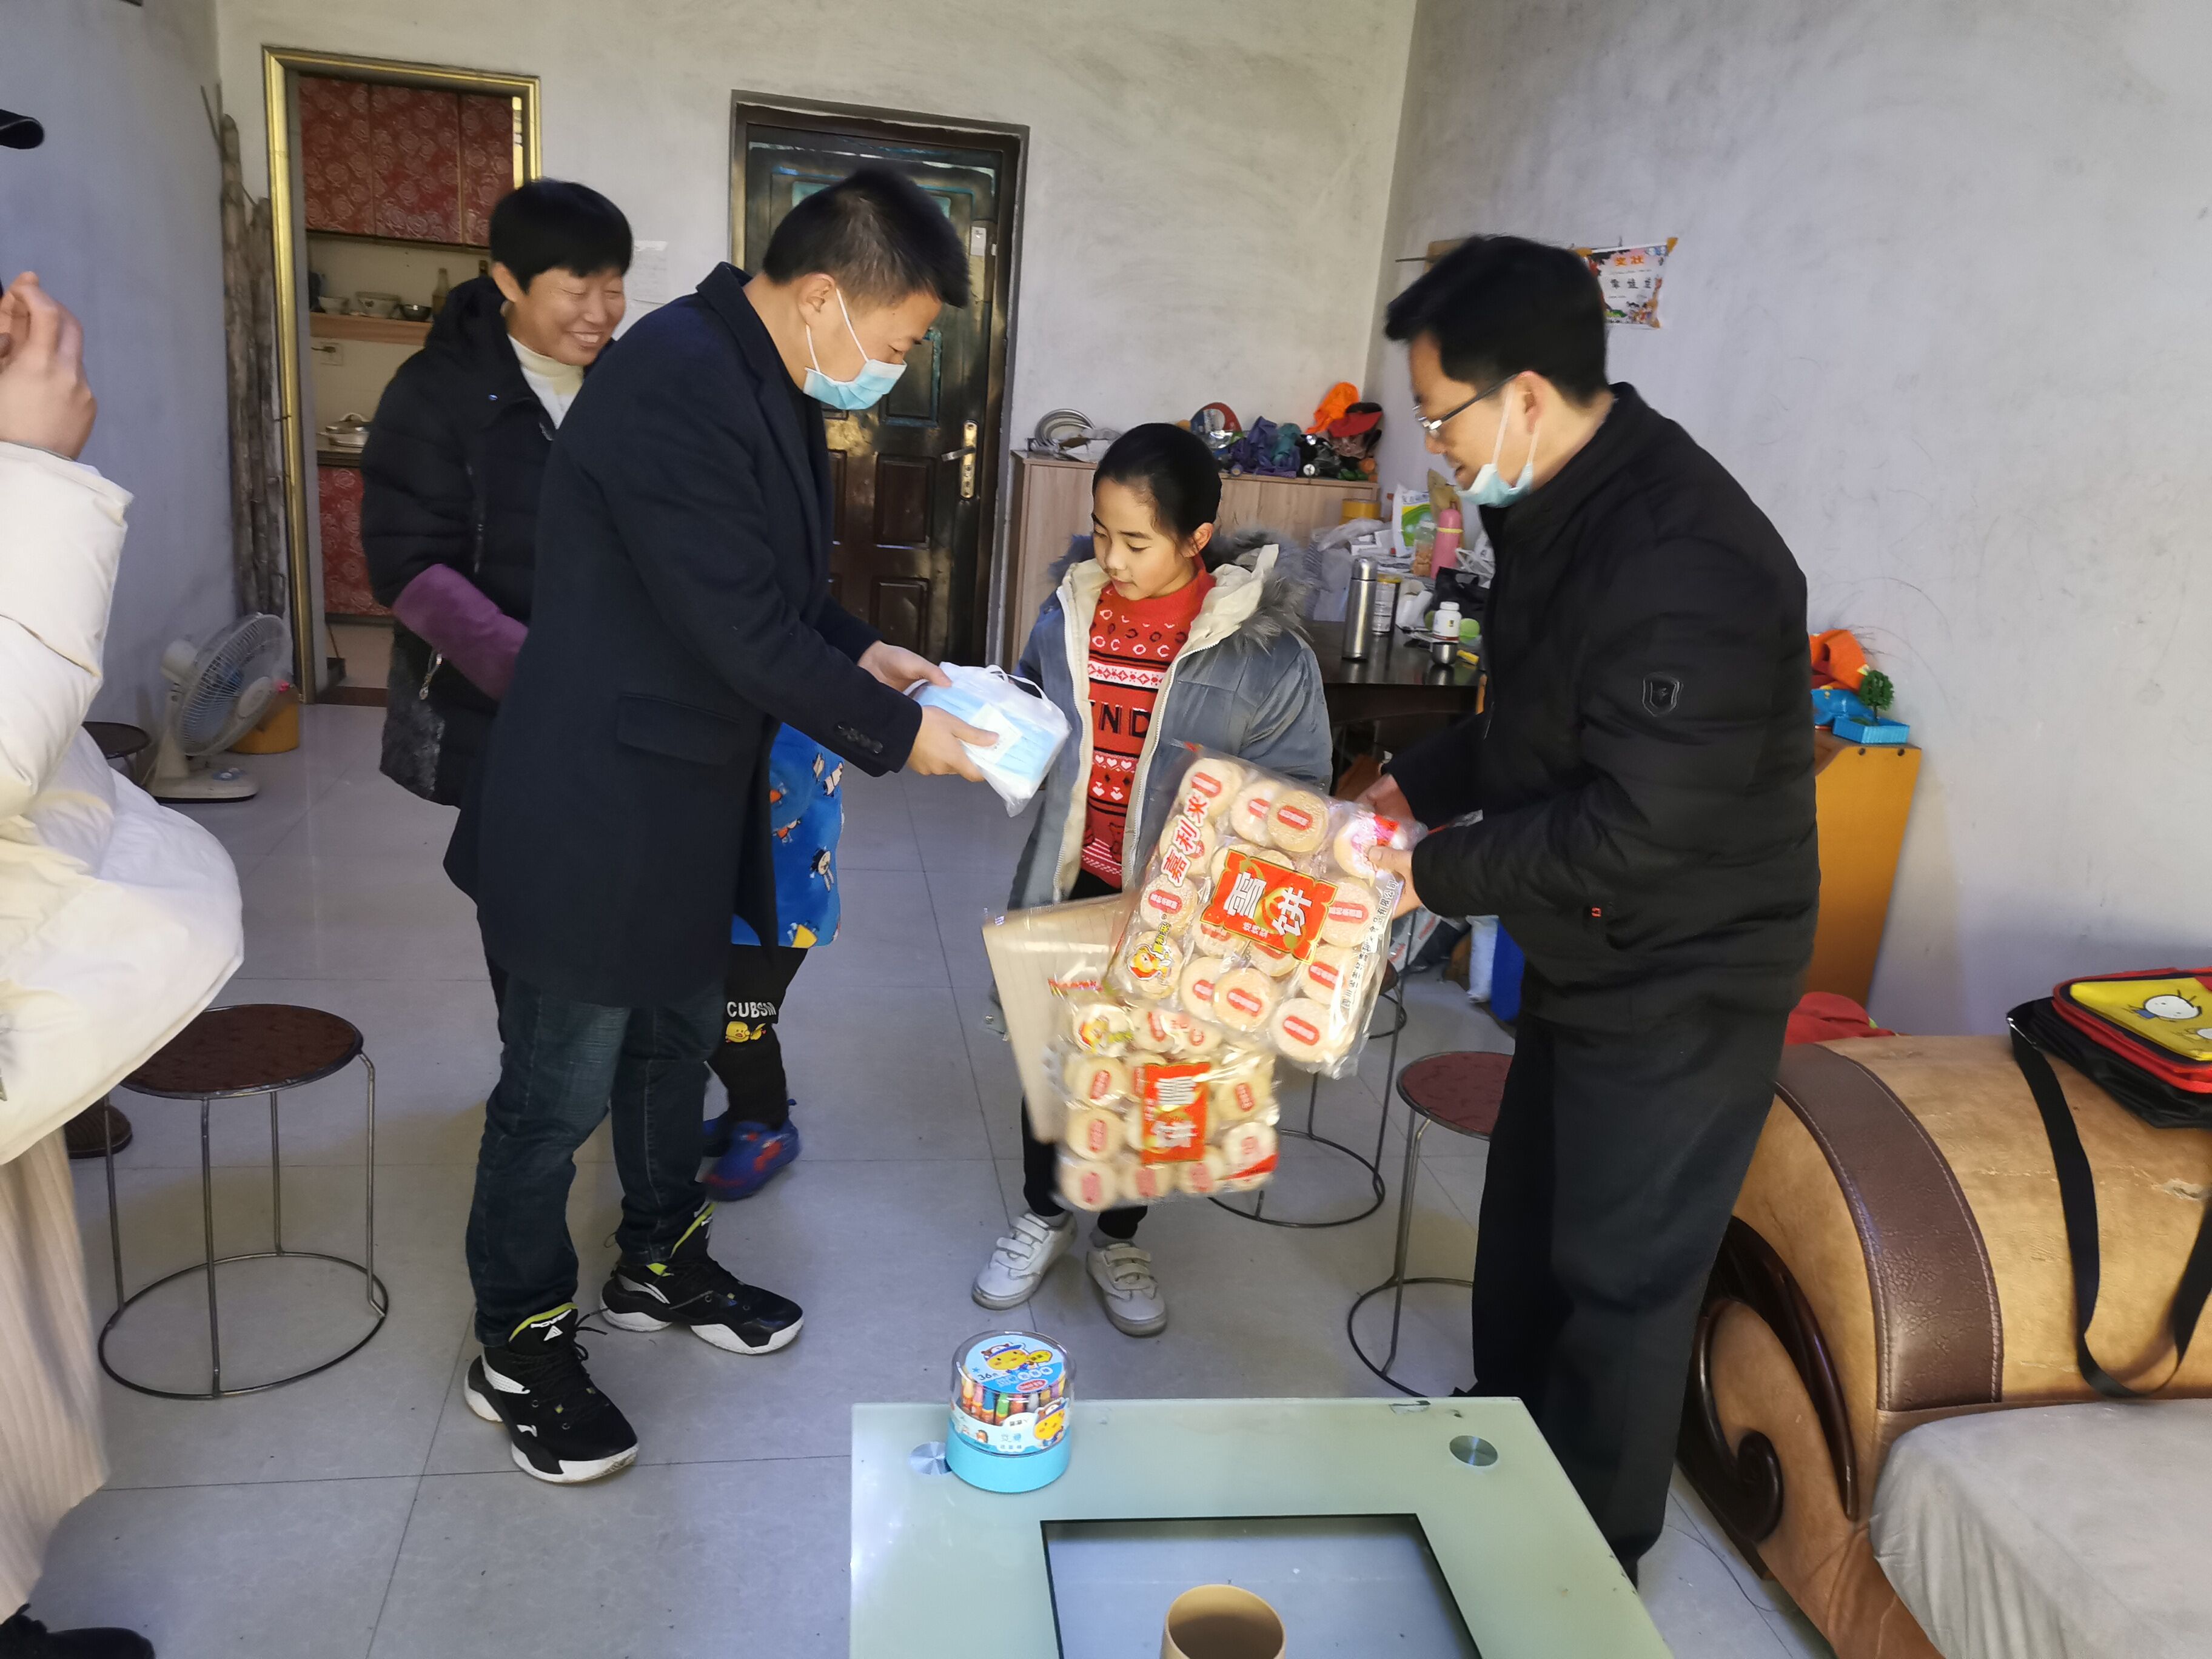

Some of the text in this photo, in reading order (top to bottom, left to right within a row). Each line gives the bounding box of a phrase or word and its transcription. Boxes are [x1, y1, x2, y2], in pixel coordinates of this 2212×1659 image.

[1091, 700, 1151, 737] ND
[1162, 794, 1209, 885] 嘉利来
[1223, 871, 1313, 936] 雪饼
